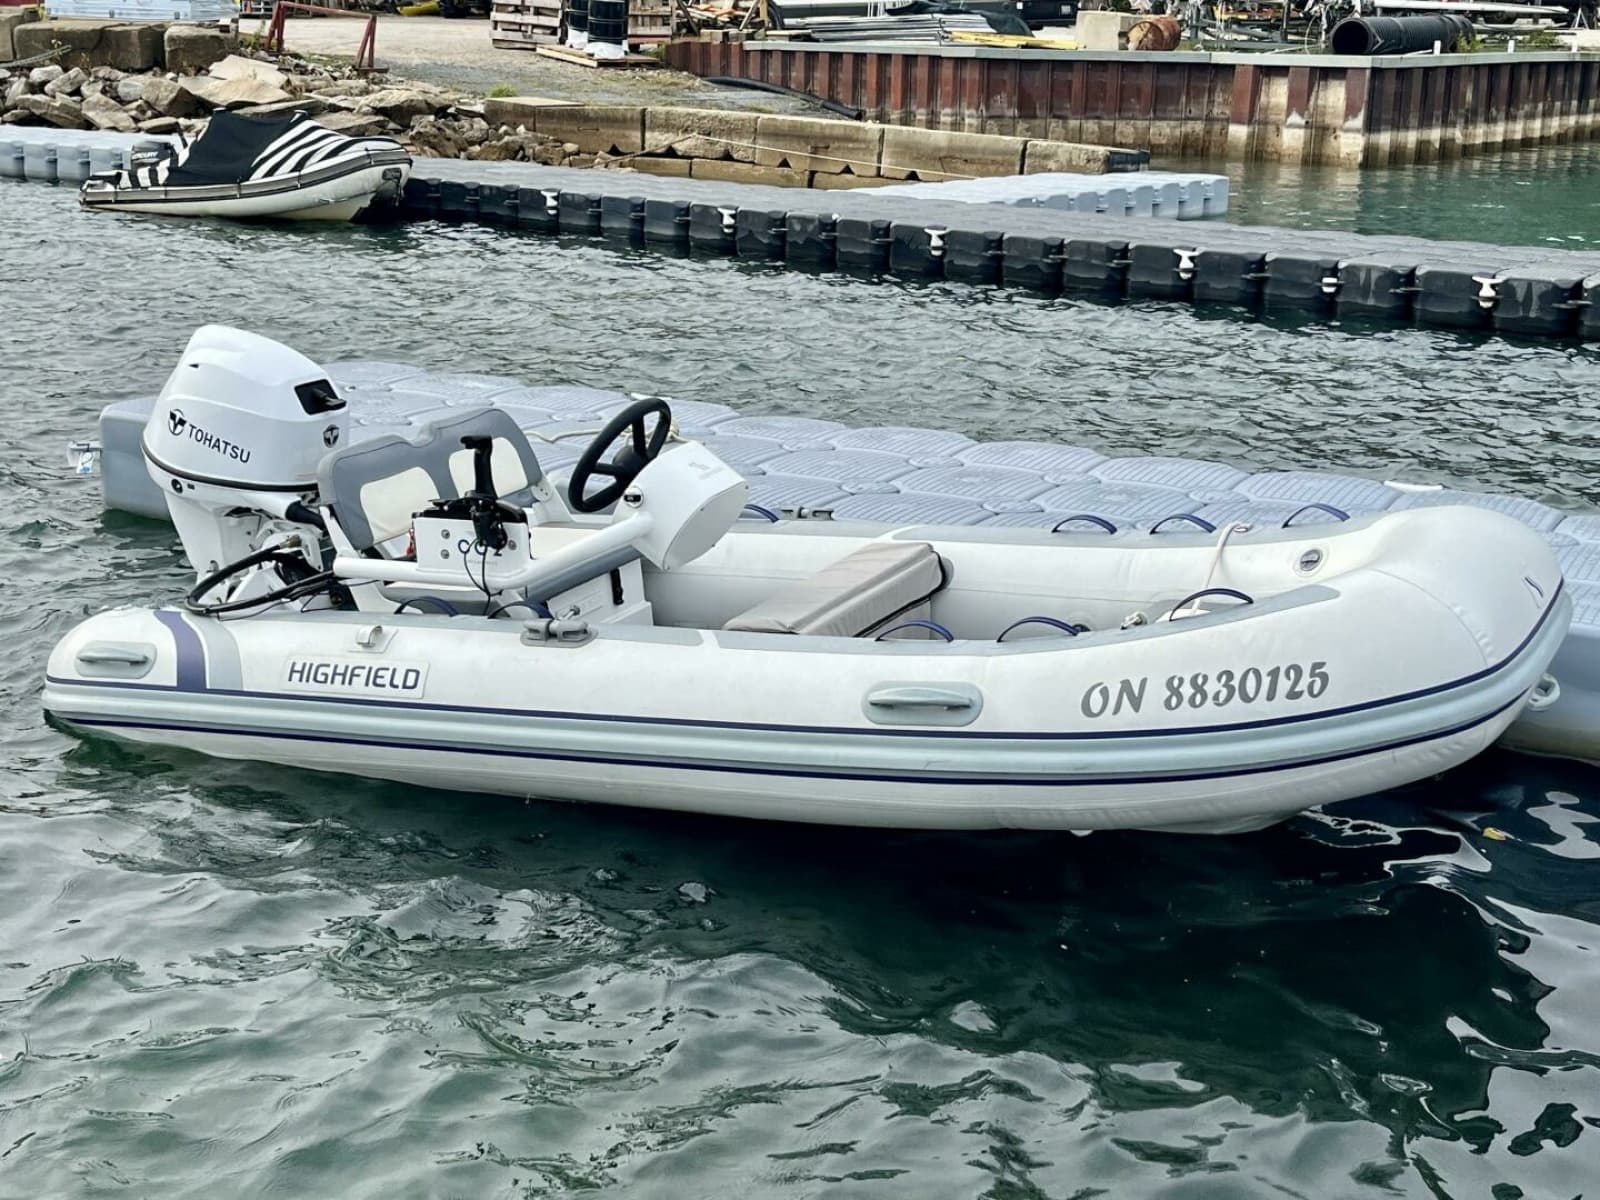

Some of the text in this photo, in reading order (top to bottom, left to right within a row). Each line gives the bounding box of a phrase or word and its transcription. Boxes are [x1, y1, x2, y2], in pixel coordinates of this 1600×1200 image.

[189, 424, 251, 463] TOHATSU
[288, 662, 421, 690] HIGHFIELD
[1081, 661, 1330, 718] ON 8830125
